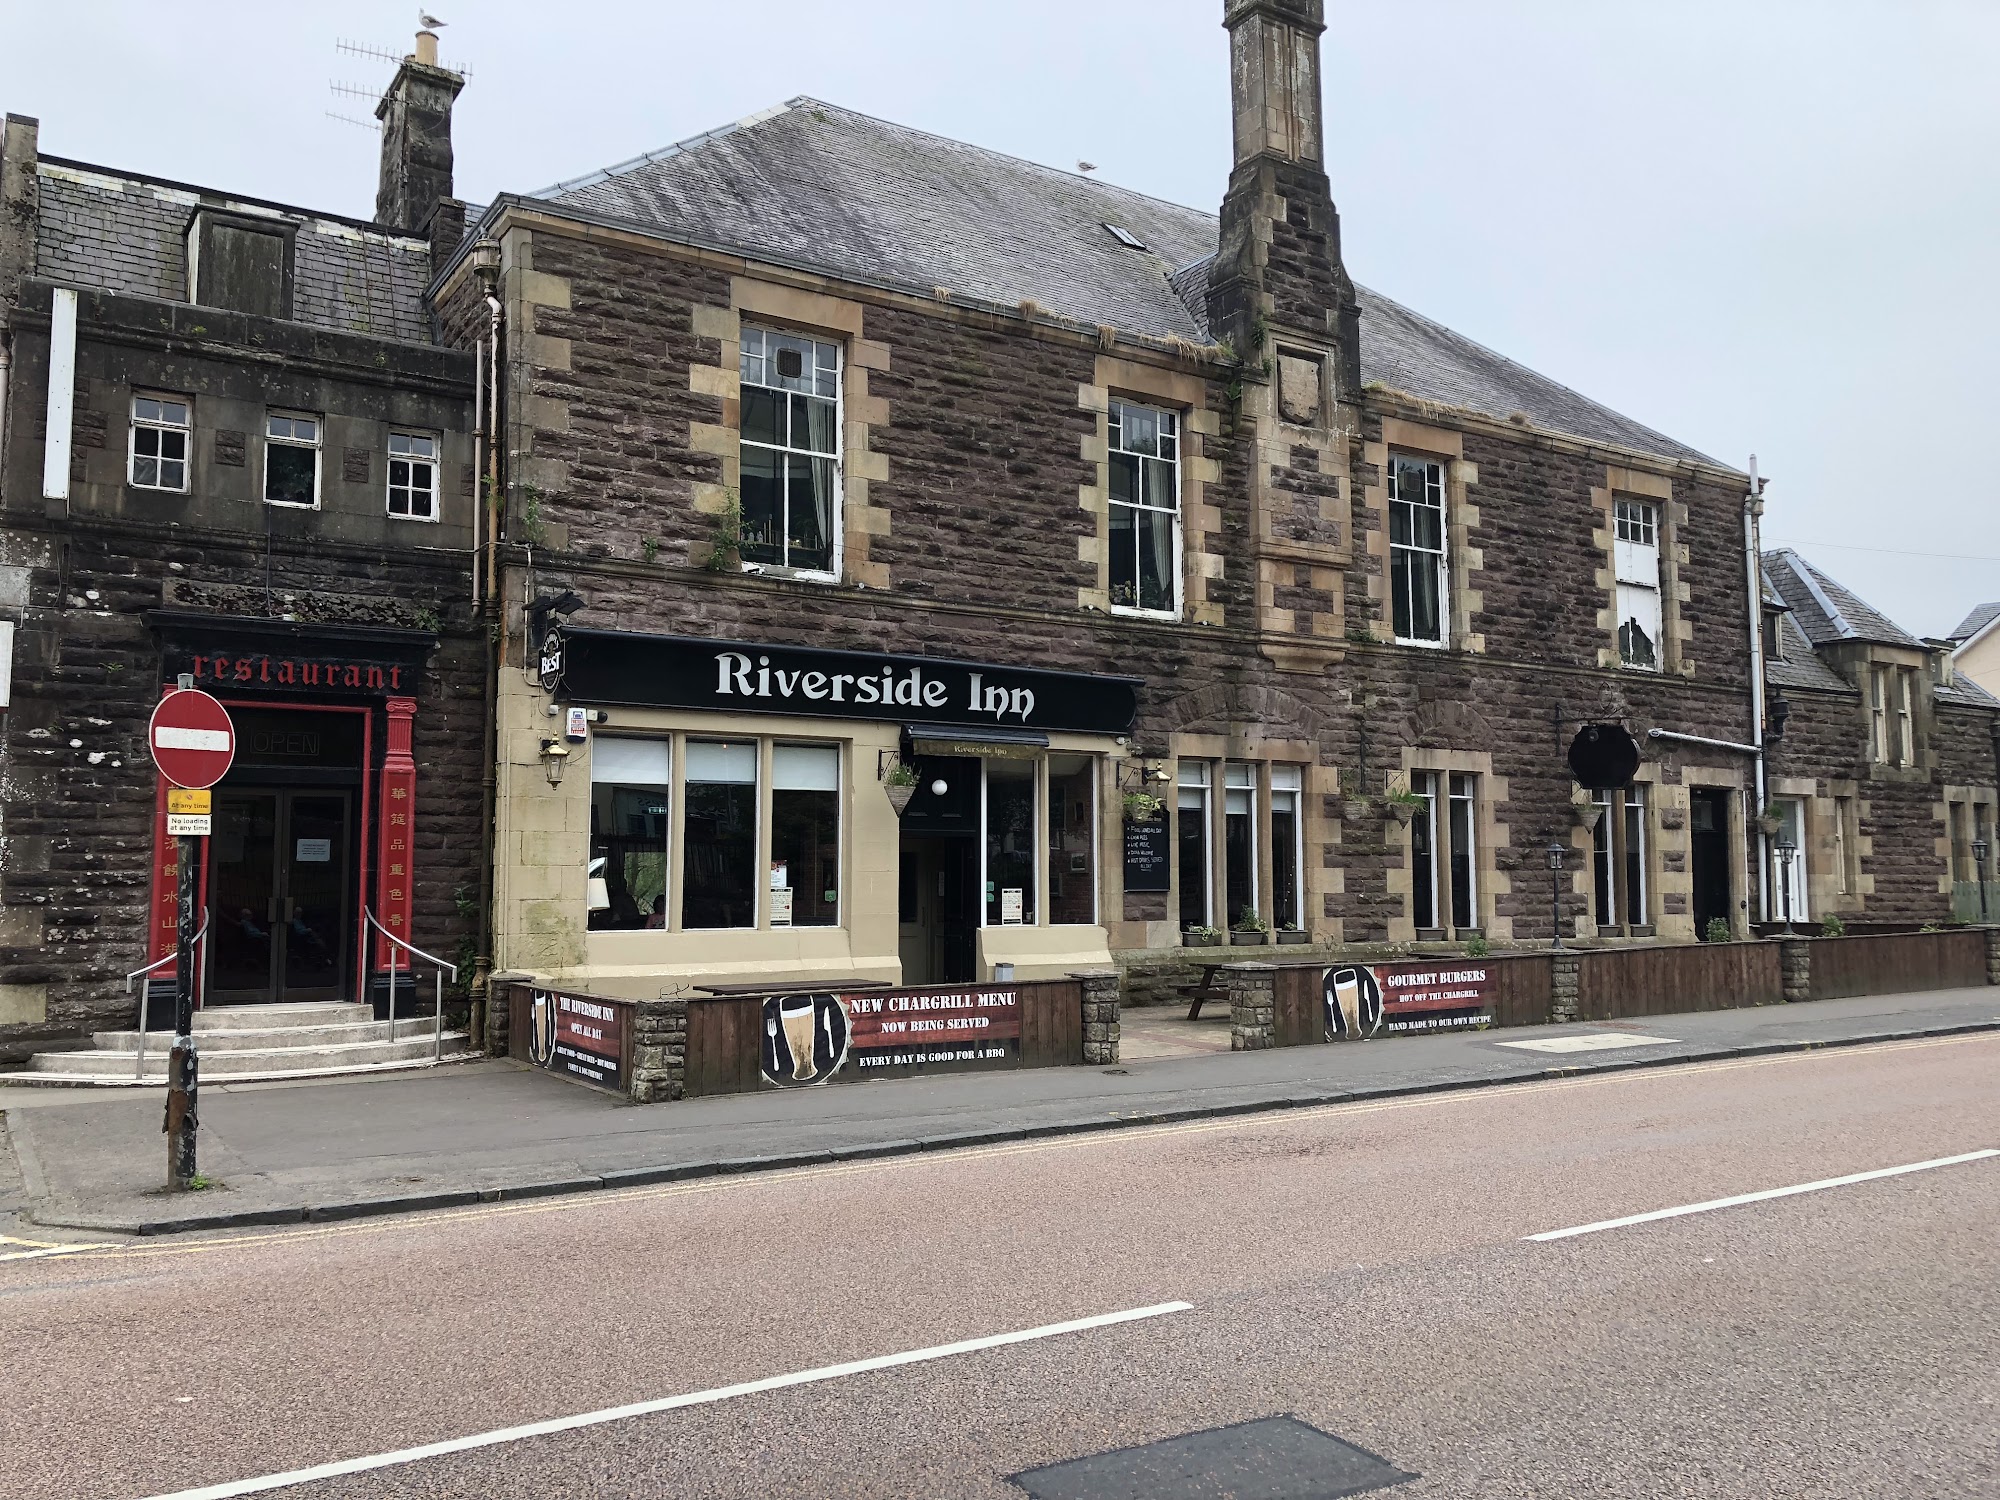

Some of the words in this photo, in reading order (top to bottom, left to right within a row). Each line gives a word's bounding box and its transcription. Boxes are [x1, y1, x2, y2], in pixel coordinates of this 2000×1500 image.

[192, 655, 402, 690] restaurant
[541, 651, 561, 675] BEST
[714, 652, 948, 707] Riverside
[967, 672, 1035, 723] Inn
[253, 732, 317, 754] OPEN
[954, 745, 992, 754] Riverside
[994, 747, 1007, 756] Inn
[1387, 972, 1437, 987] GOURMET
[1439, 969, 1486, 983] BURGERS
[850, 998, 884, 1014] NEW
[888, 994, 974, 1012] CHARGRILL
[976, 992, 1017, 1007] MENU
[1399, 994, 1414, 1003] HOT
[1414, 993, 1428, 1002] OFF
[1428, 992, 1442, 1000] THE
[1443, 989, 1479, 999] CHARGRILL
[560, 996, 571, 1012] THE
[571, 999, 602, 1020] RIVERSIDE
[602, 1006, 614, 1022] INN
[570, 1022, 583, 1035] OPEN
[583, 1025, 592, 1038] ALL
[592, 1028, 602, 1040] DAY
[881, 1021, 908, 1034] NOW
[910, 1019, 944, 1032] BEING
[946, 1016, 990, 1030] SERVED
[1388, 1022, 1407, 1031] HAND
[1408, 1020, 1427, 1029] MADE
[1428, 1019, 1437, 1028] TO
[1438, 1018, 1452, 1027] OUR
[1453, 1017, 1468, 1026] OWN
[1468, 1015, 1492, 1024] RECIPE
[859, 1055, 892, 1067] EVERY
[893, 1053, 914, 1065] DAY
[916, 1053, 926, 1063] IS
[928, 1051, 954, 1063] GOOD
[956, 1050, 975, 1061] FOR
[976, 1049, 984, 1059] A
[986, 1048, 1005, 1058] BBQ
